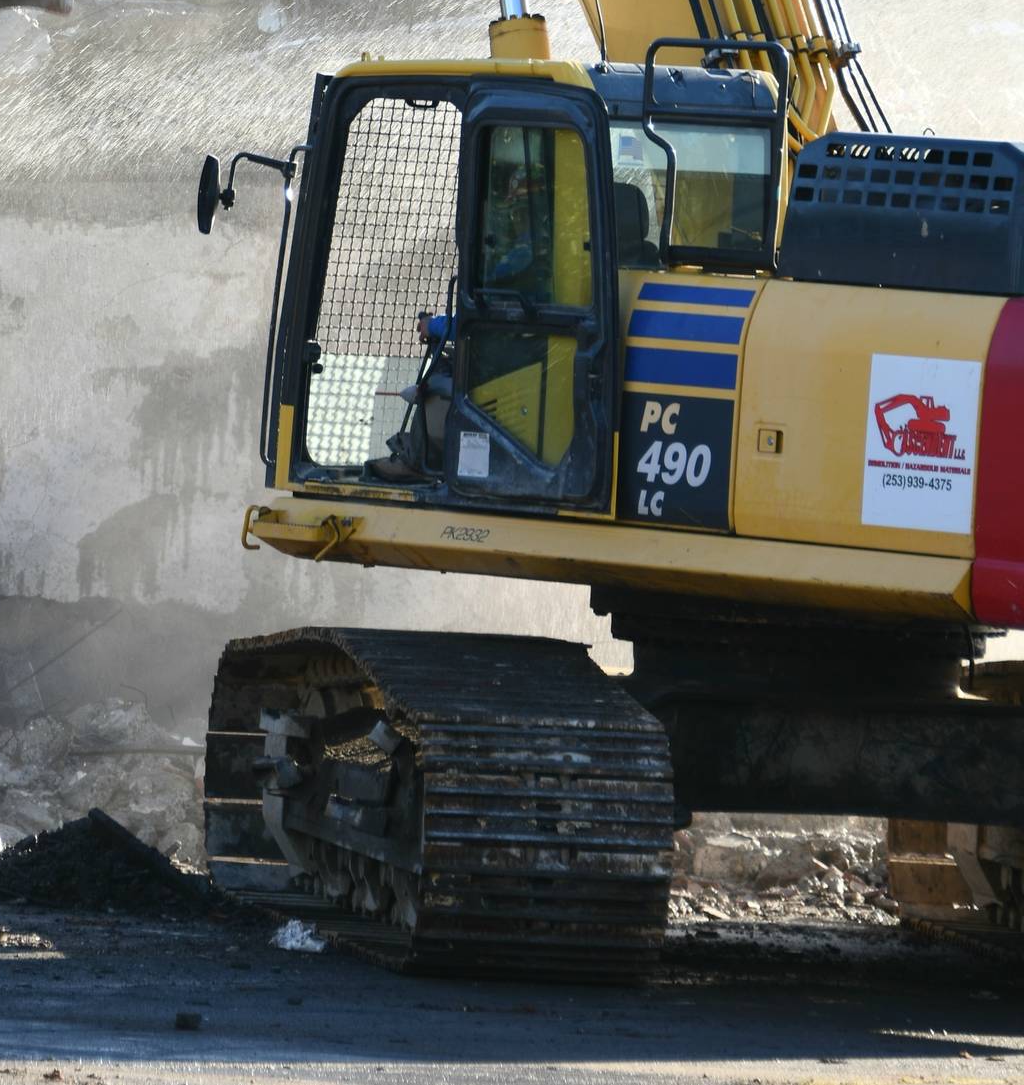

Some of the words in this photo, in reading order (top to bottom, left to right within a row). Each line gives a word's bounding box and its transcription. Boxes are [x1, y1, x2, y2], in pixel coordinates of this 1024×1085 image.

[640, 401, 681, 435] PC
[637, 441, 712, 487] 490
[638, 490, 665, 517] LC
